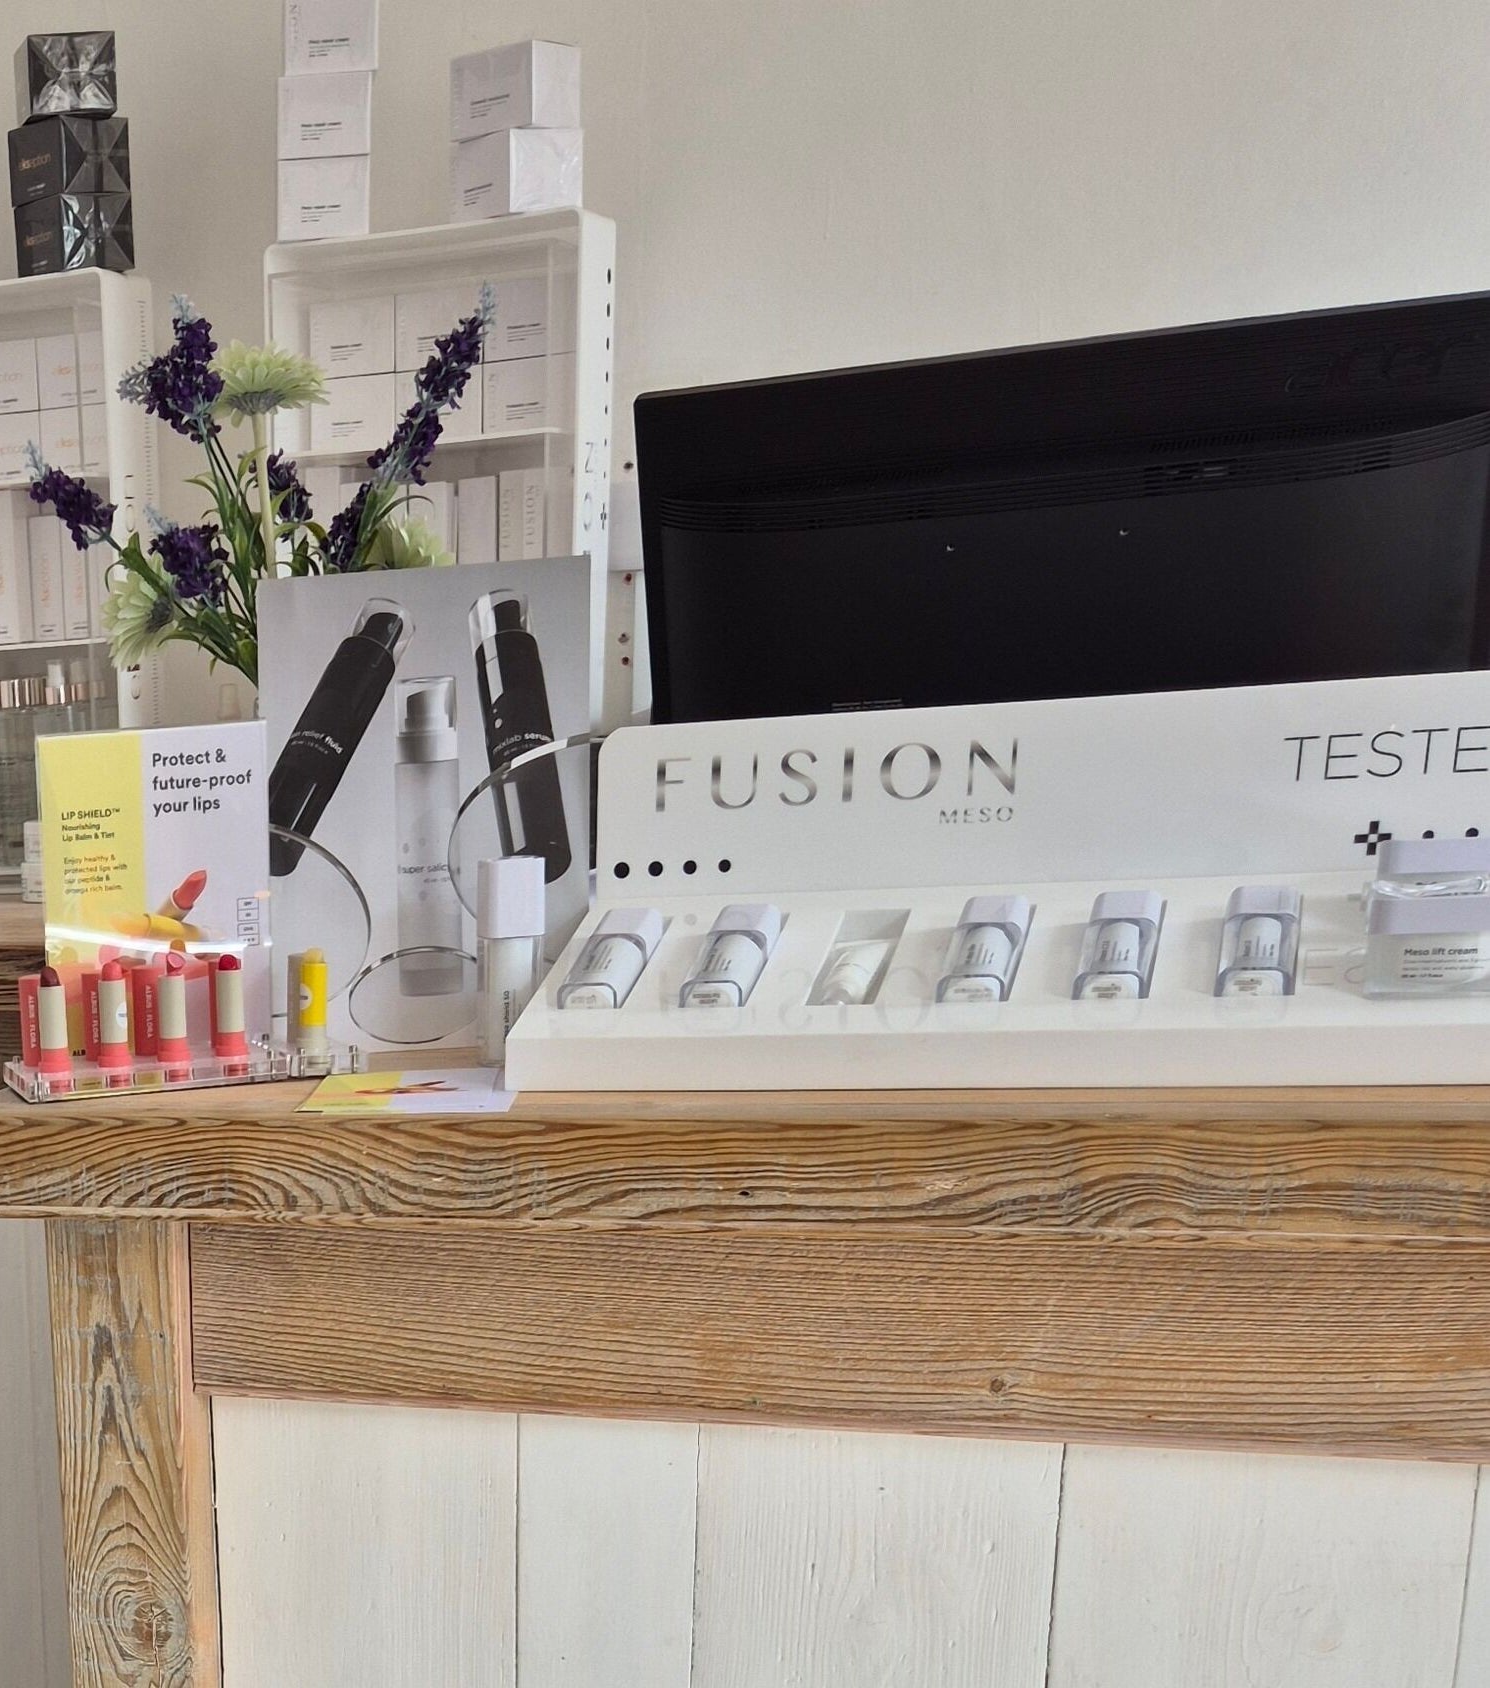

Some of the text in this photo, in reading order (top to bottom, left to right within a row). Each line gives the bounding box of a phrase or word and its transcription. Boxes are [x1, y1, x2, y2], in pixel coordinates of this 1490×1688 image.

[324, 735, 344, 754] fluid
[1283, 724, 1490, 782] TESTE
[152, 748, 227, 768] Protect &
[152, 769, 252, 791] future-proof
[655, 737, 1019, 813] FUSION
[61, 811, 76, 821] LIP
[153, 796, 221, 818] your lips
[939, 805, 1015, 825] MESO
[61, 823, 101, 831] Nourishing
[62, 834, 73, 842] Lip
[75, 833, 93, 841] Balm
[1403, 947, 1479, 956] Meso lift cream
[72, 1049, 86, 1057] ALB
